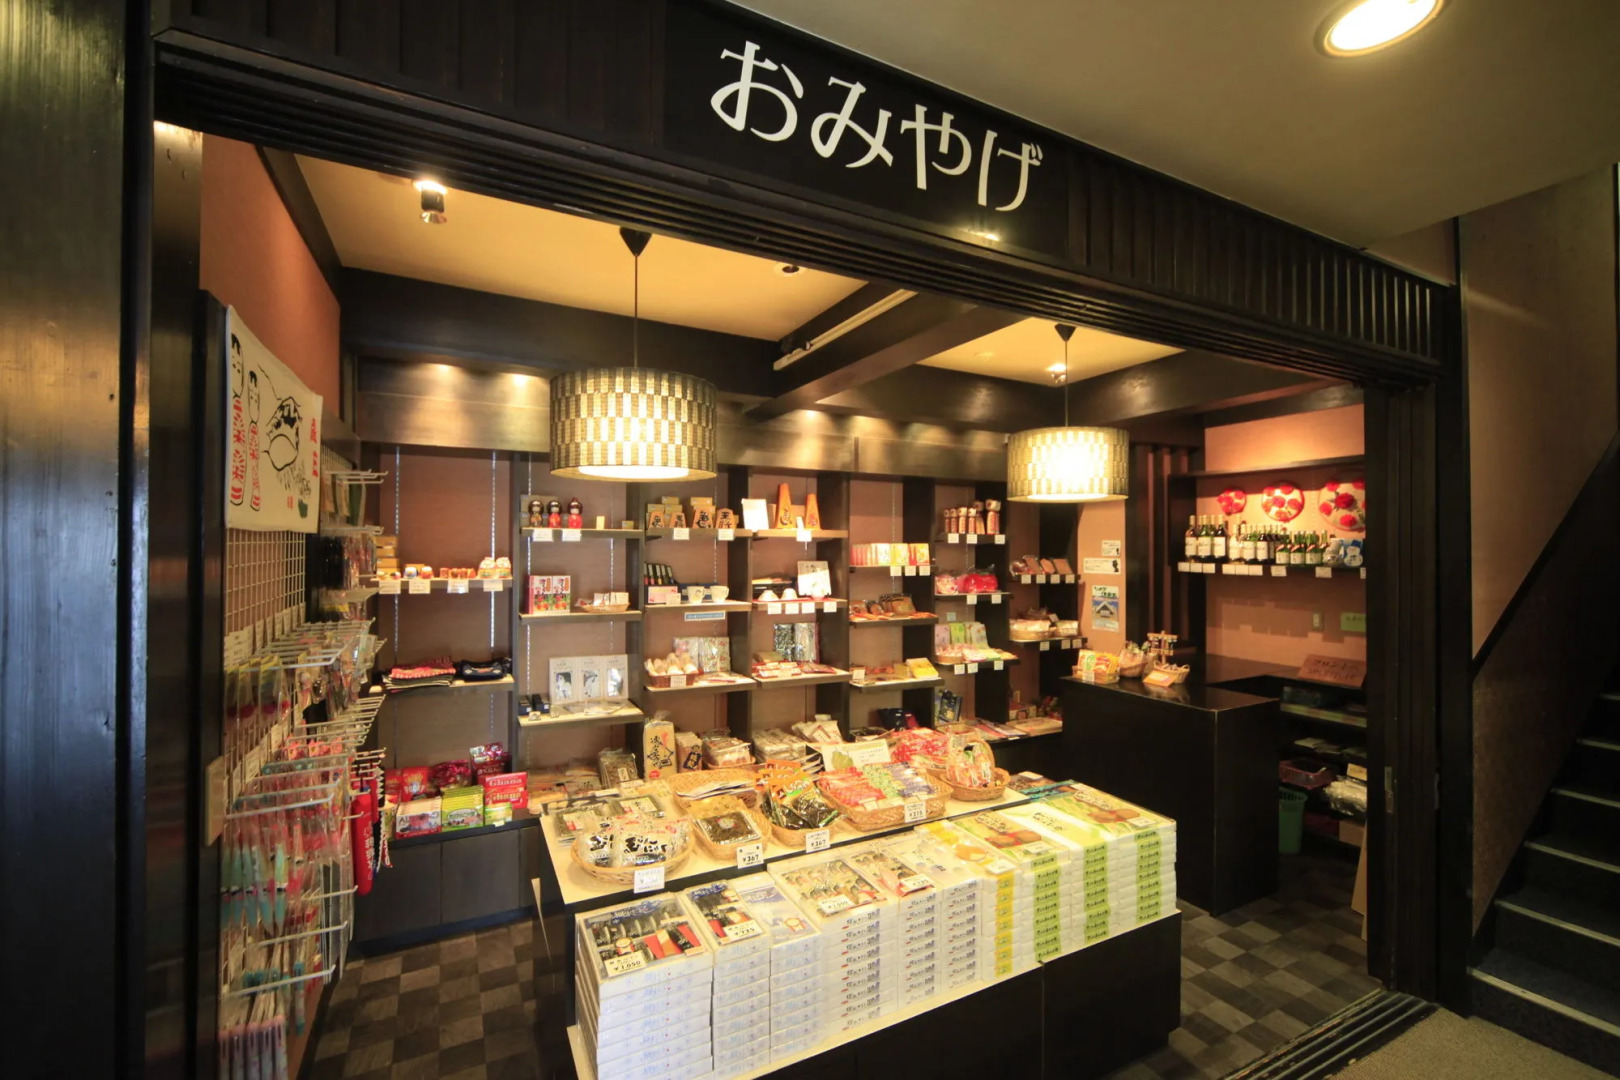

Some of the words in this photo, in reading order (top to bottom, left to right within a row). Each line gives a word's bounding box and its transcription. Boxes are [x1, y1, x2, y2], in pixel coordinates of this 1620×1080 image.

[710, 40, 1044, 212] おみやげ
[488, 777, 523, 787] Ghana
[743, 854, 760, 863] ¥367
